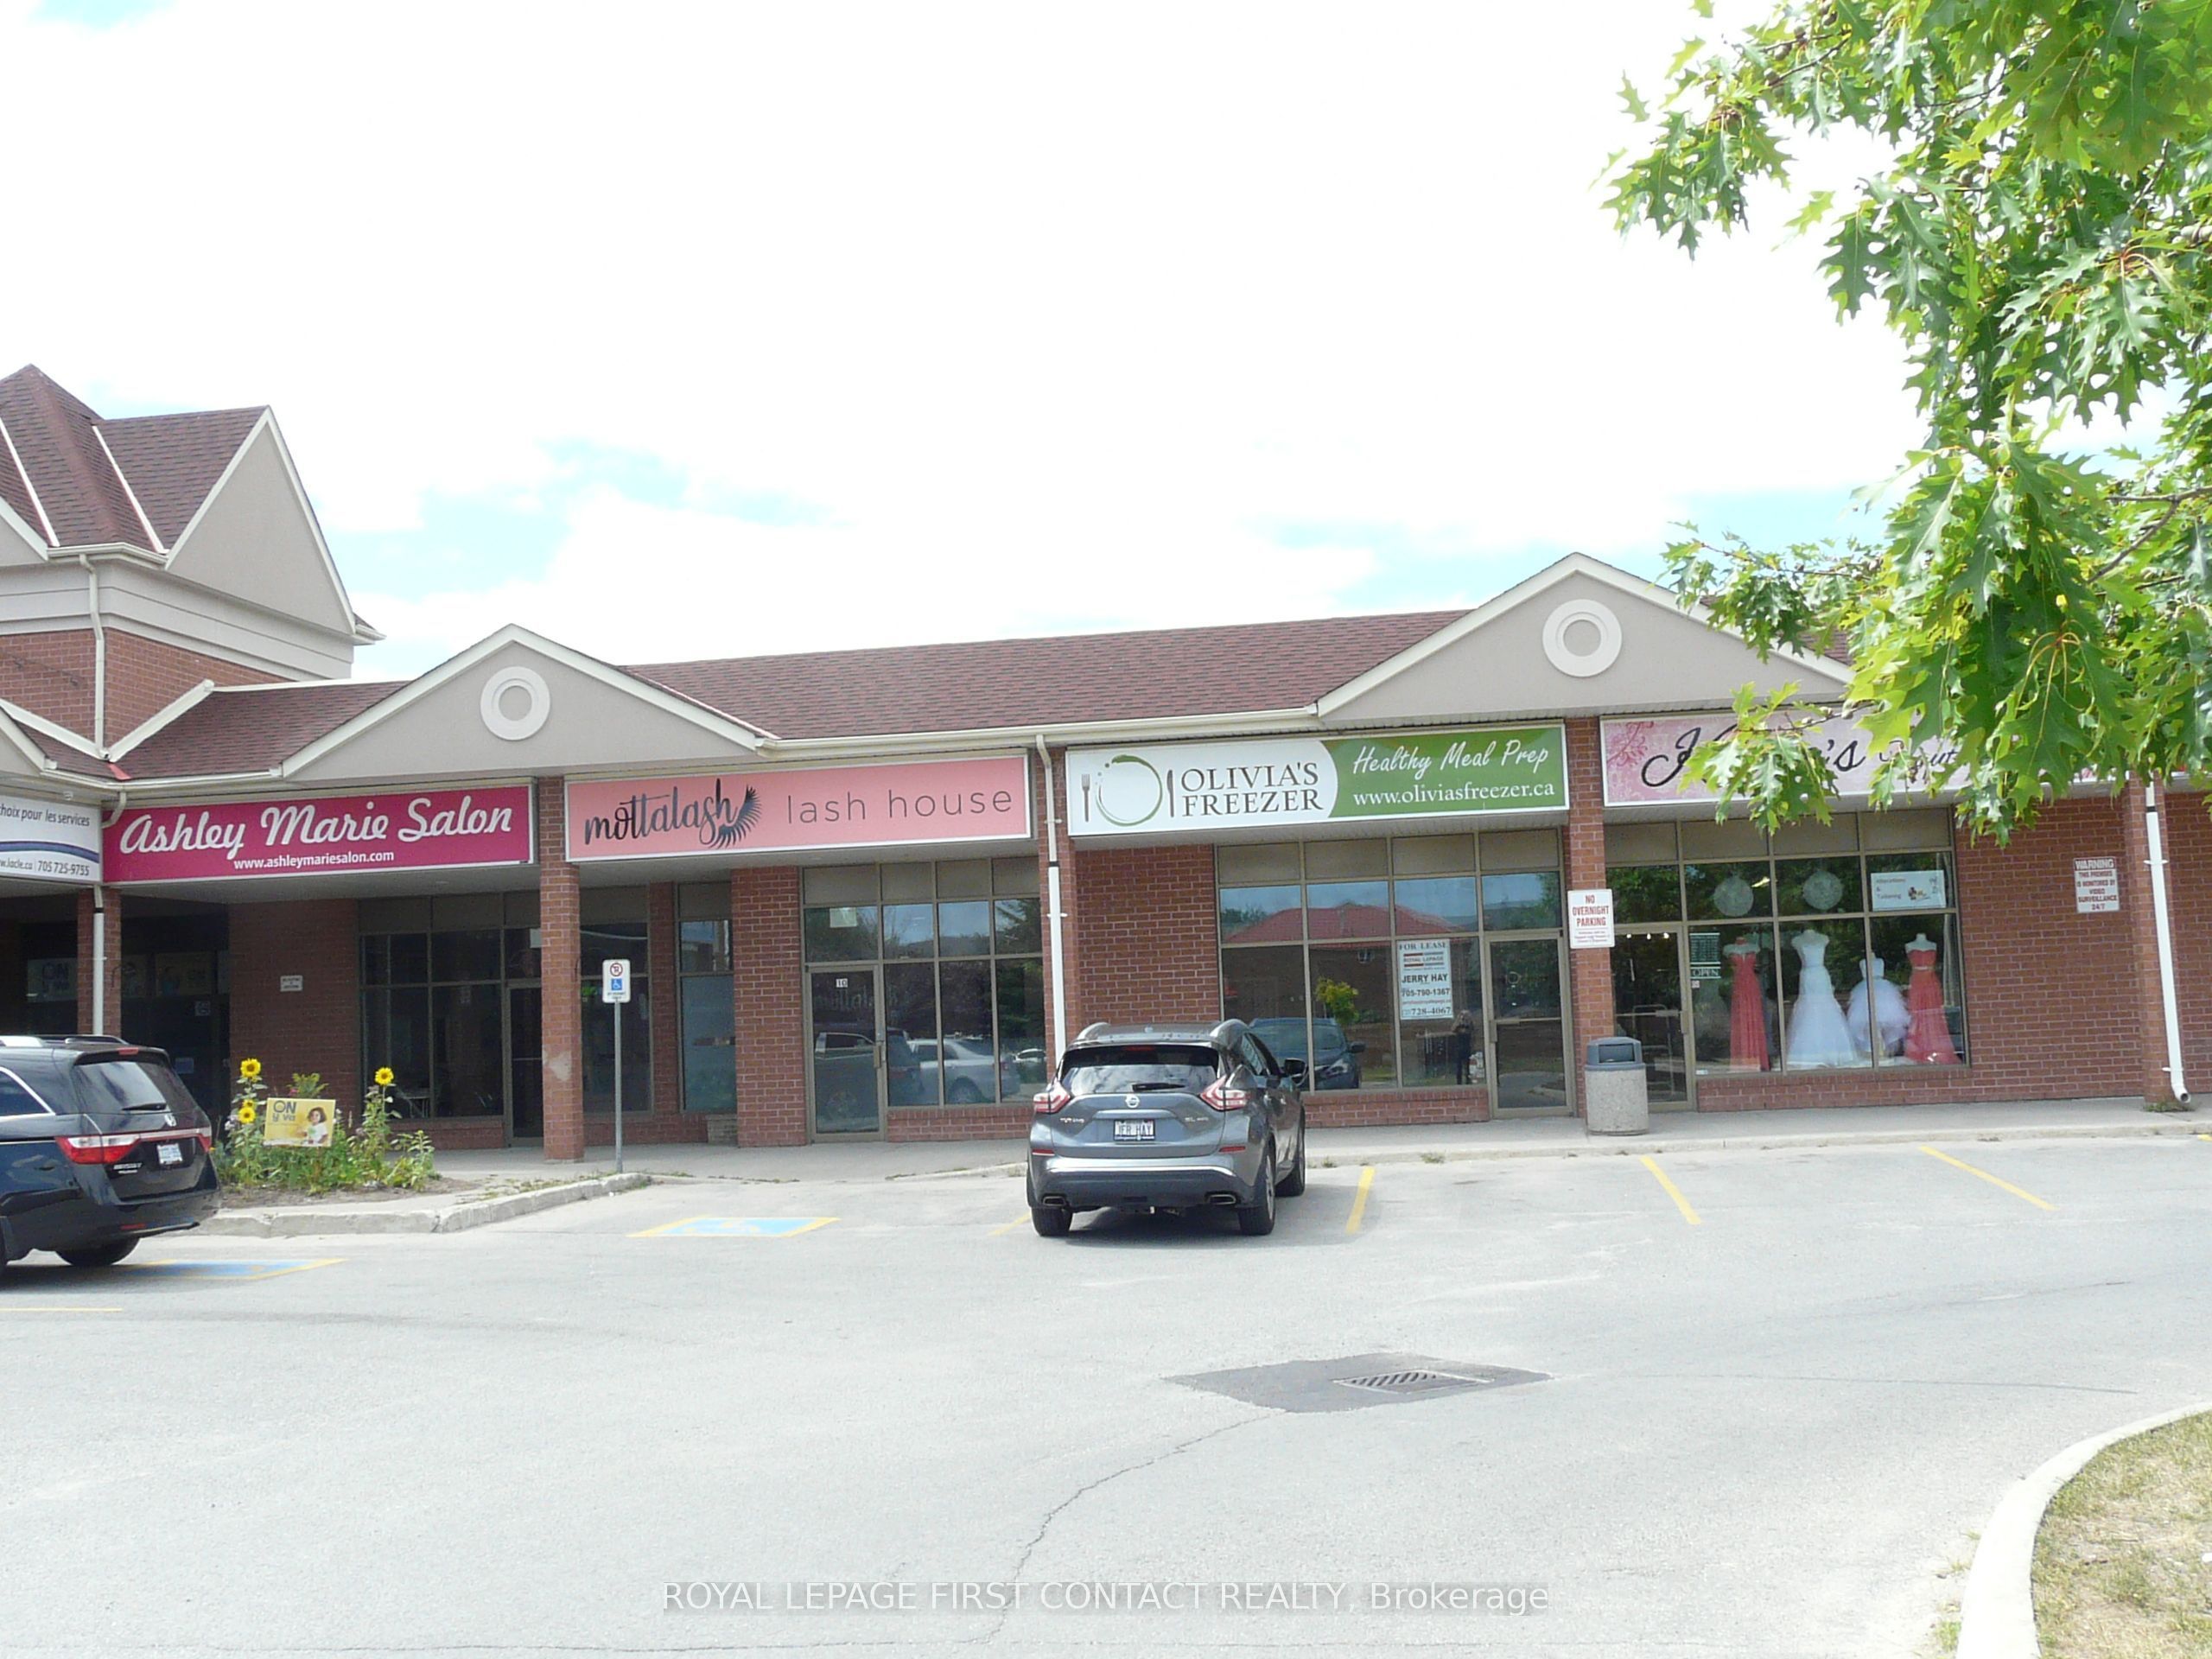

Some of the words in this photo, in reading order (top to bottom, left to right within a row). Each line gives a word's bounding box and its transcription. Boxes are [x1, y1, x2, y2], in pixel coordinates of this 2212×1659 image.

[1353, 745, 1433, 780] Healthy
[1440, 741, 1497, 771] Meal
[1501, 739, 1549, 774] Prep
[1181, 761, 1319, 792] OLIVIA'S
[1353, 781, 1555, 805] www.oliviasfreezer.ca
[584, 778, 738, 845] mottalash
[786, 794, 867, 824] lash
[887, 788, 1013, 819] house
[1182, 788, 1324, 817] FREEZER
[21, 809, 42, 823] pour
[45, 810, 56, 823] les
[58, 813, 90, 827] services
[119, 810, 245, 861] Ashley
[260, 801, 390, 846] Marie
[397, 795, 512, 843] Salon
[38, 860, 53, 873] 705
[233, 851, 395, 870] www.ashleymariesalon.com
[2075, 858, 2114, 871] WARNING
[1585, 894, 1596, 904] NO
[1572, 906, 1609, 916] OVERNIGHT
[1576, 917, 1606, 927] PARKING
[1402, 975, 1428, 983] JERRY
[1431, 973, 1448, 982] HAY
[273, 1100, 297, 1114] ON
